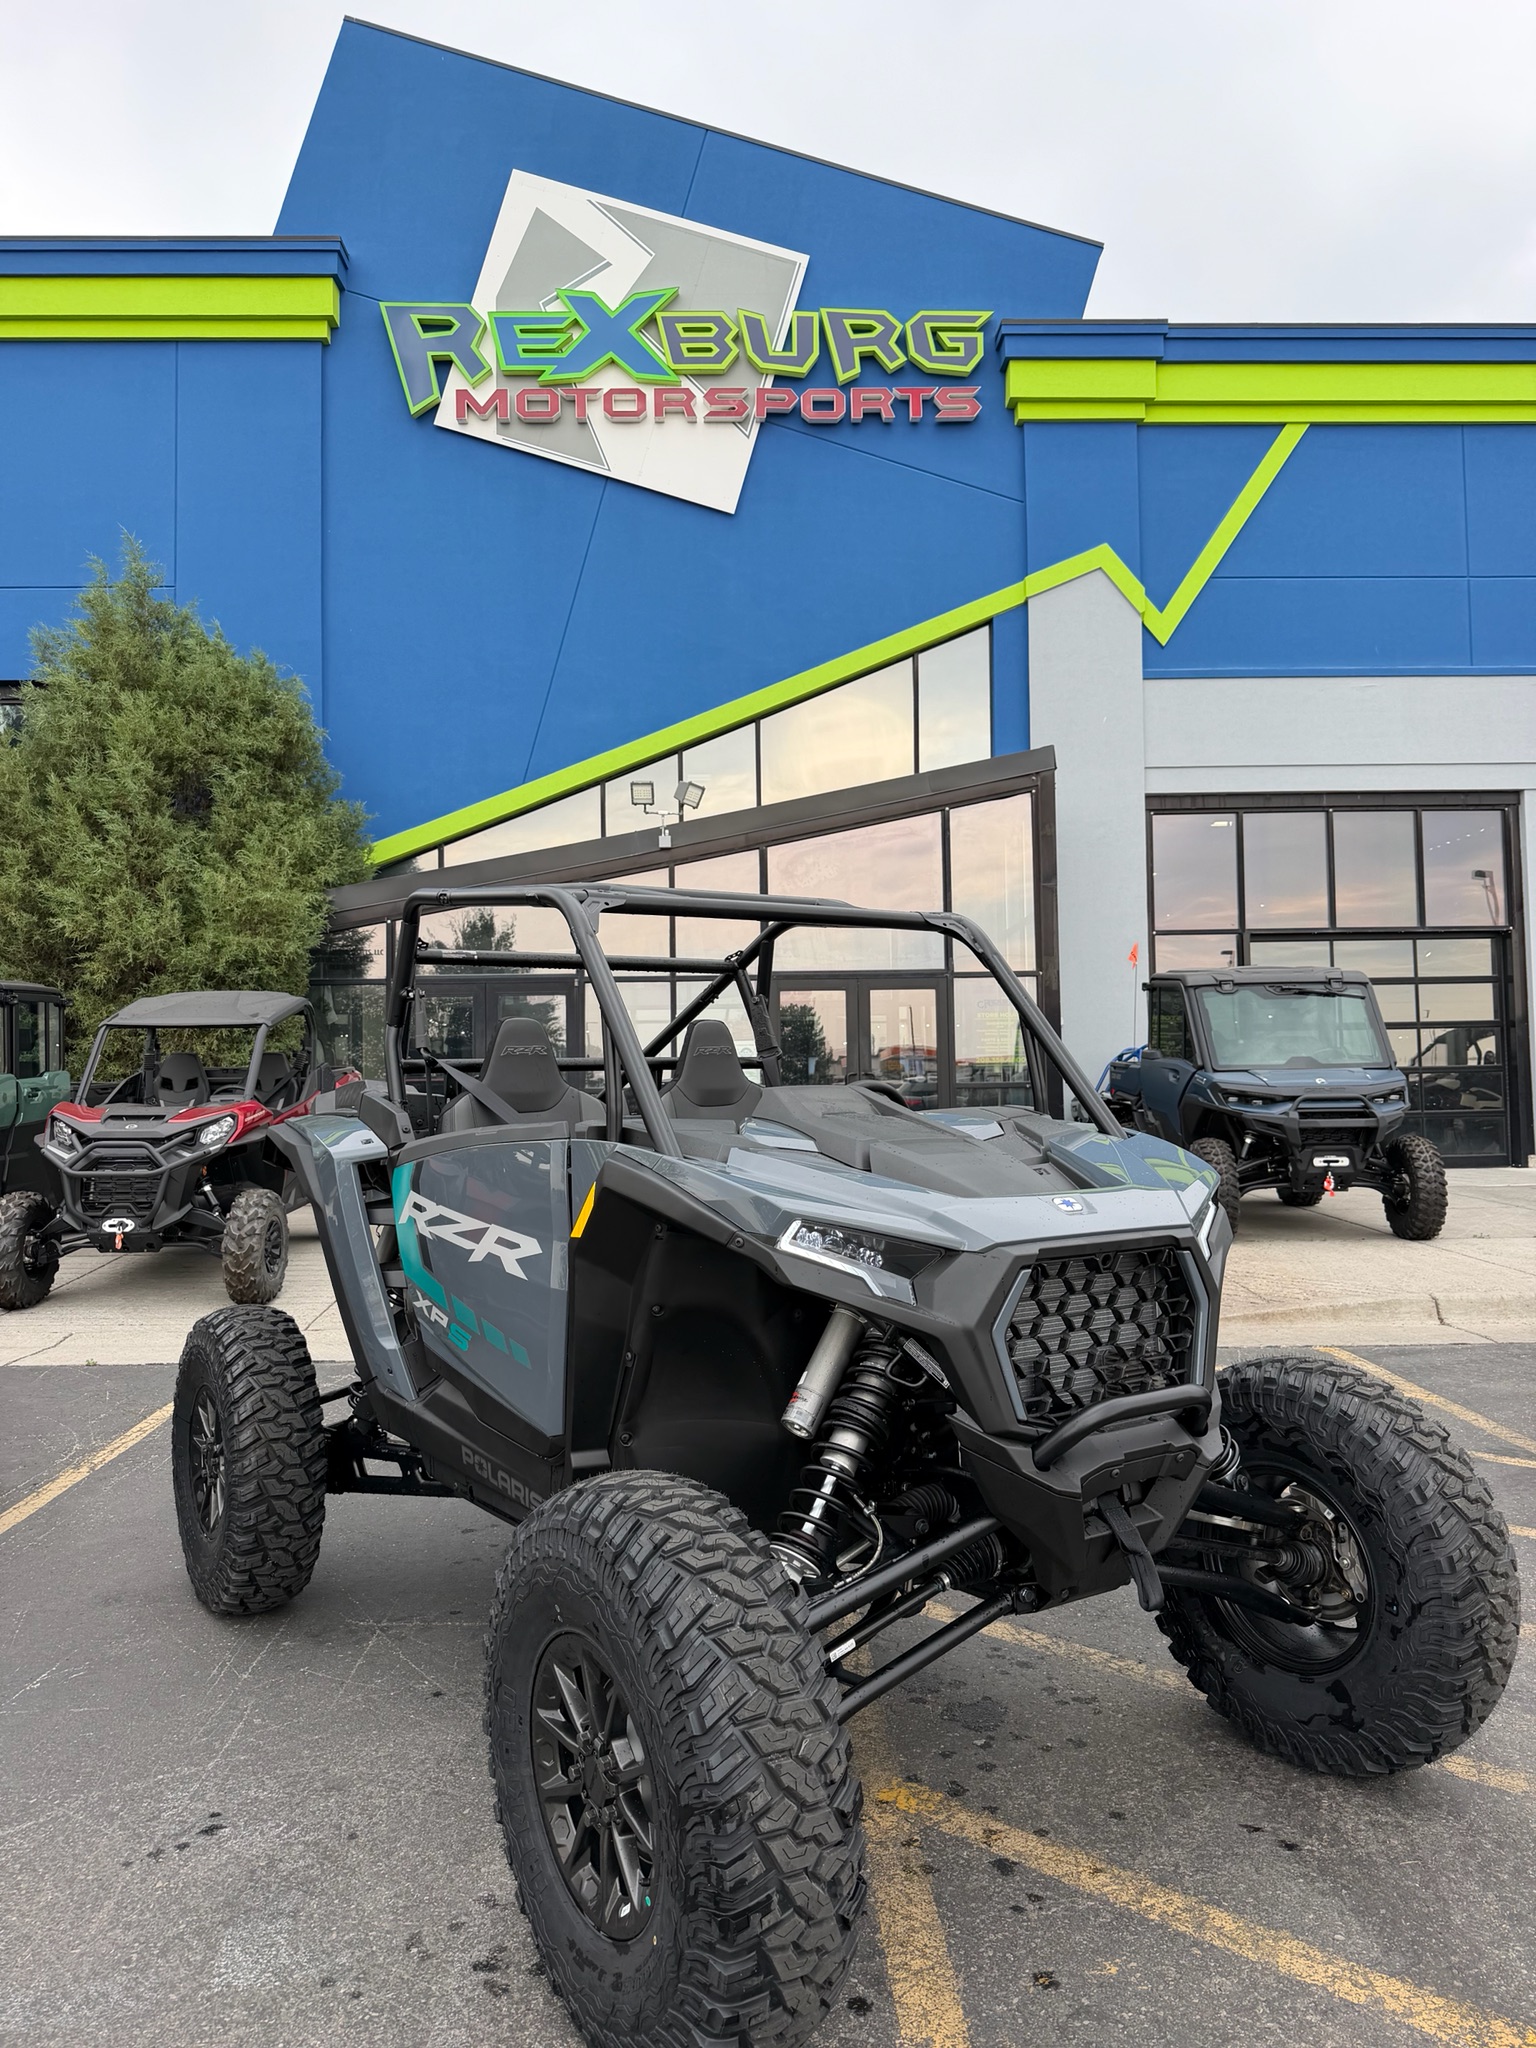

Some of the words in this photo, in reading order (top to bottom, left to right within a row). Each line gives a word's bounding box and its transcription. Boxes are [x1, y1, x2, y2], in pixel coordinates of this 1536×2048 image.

[379, 287, 995, 418] REXBURG
[455, 386, 983, 425] MOTORSPORTS
[500, 1045, 548, 1057] RZR
[693, 1045, 732, 1057] RZR
[399, 1190, 543, 1281] RZR
[461, 1444, 544, 1510] POLARIS
